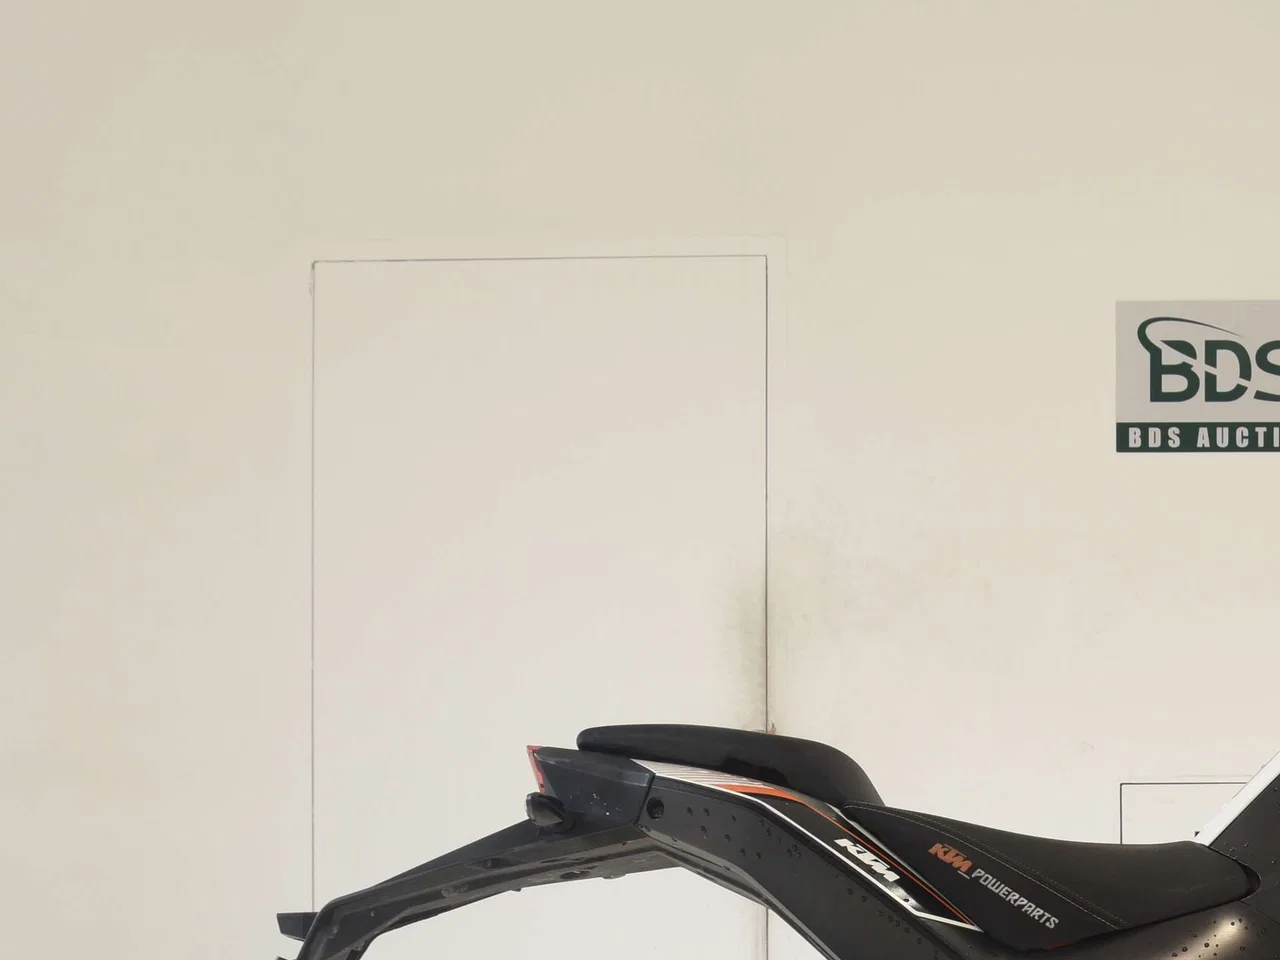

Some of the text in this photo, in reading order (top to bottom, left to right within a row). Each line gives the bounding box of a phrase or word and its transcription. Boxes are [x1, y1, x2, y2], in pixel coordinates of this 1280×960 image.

[1128, 427, 1181, 448] BDS
[834, 838, 900, 882] KTM
[928, 843, 1059, 929] KTM POWERPARTS
